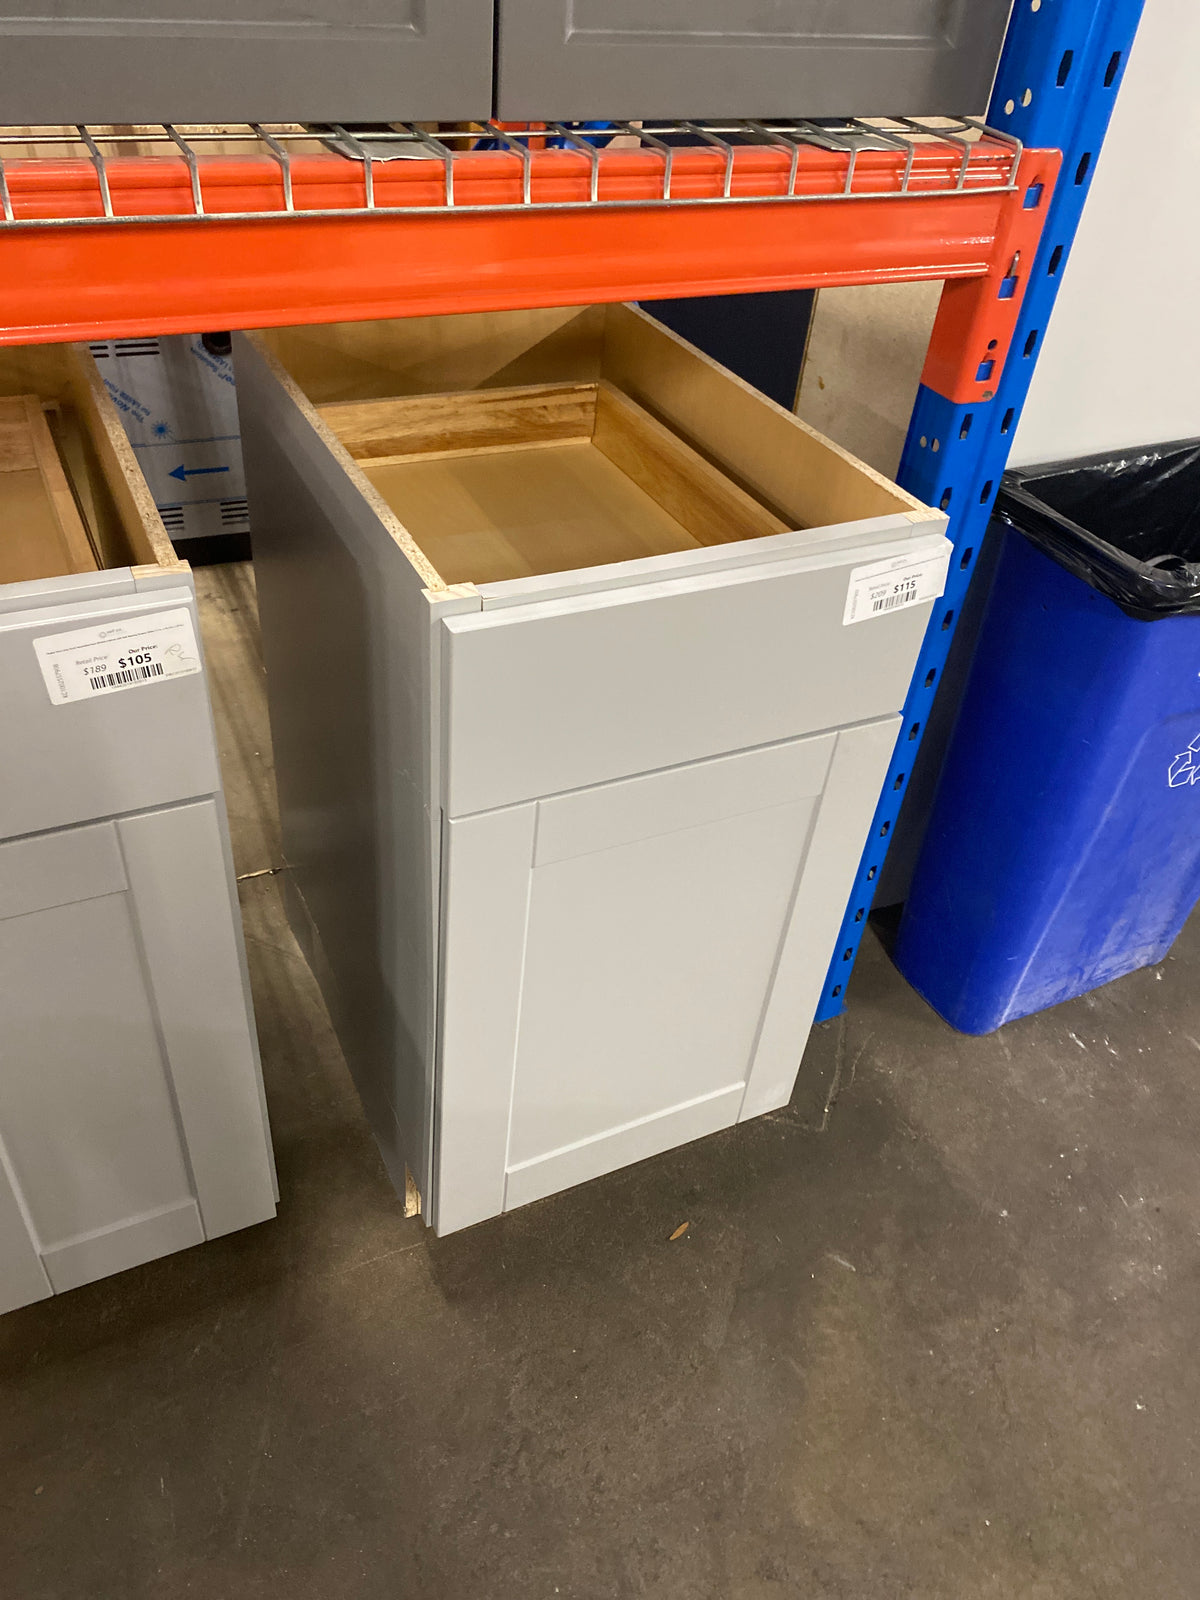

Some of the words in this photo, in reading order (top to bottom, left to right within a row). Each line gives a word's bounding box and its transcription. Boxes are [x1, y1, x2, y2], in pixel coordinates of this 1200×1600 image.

[870, 589, 887, 600] $209
[893, 580, 917, 594] $115
[141, 644, 158, 652] Price:
[83, 663, 107, 676] $189
[118, 652, 152, 669] $105
